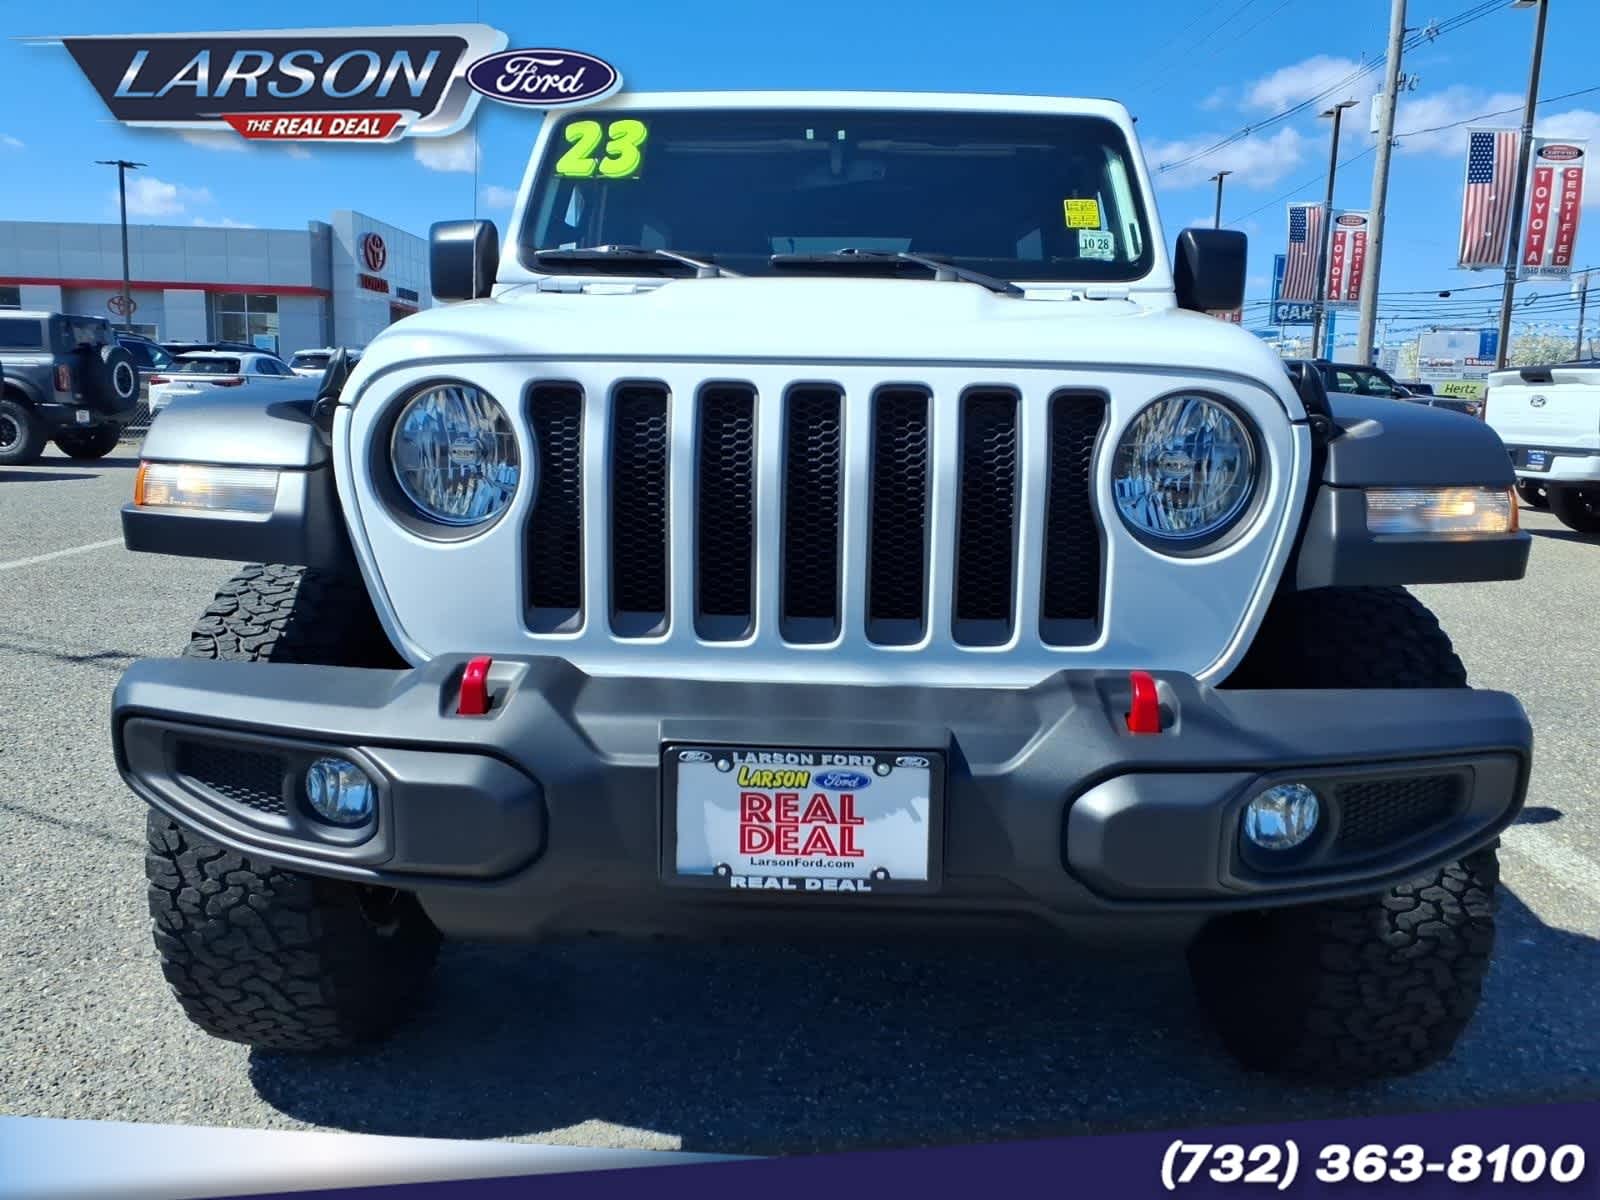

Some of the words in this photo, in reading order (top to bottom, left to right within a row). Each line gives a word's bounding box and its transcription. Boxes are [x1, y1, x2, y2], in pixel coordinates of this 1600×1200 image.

[555, 119, 648, 178] 23
[1527, 170, 1549, 263] TOYOTA
[1556, 169, 1579, 264] CERTIFIED
[1083, 239, 1095, 250] 10
[1097, 239, 1109, 249] 28
[1329, 232, 1344, 299] TOYOTA
[1349, 232, 1365, 300] CERTIFIED
[1444, 383, 1477, 394] Hertz
[732, 752, 814, 766] LARSON
[821, 754, 876, 767] FORD
[823, 773, 860, 788] Ford
[739, 792, 865, 825] REAL
[739, 825, 865, 857] DEAL
[750, 857, 855, 869] LarsonFord.com
[730, 876, 797, 891] REAL
[805, 878, 872, 892] DEAL
